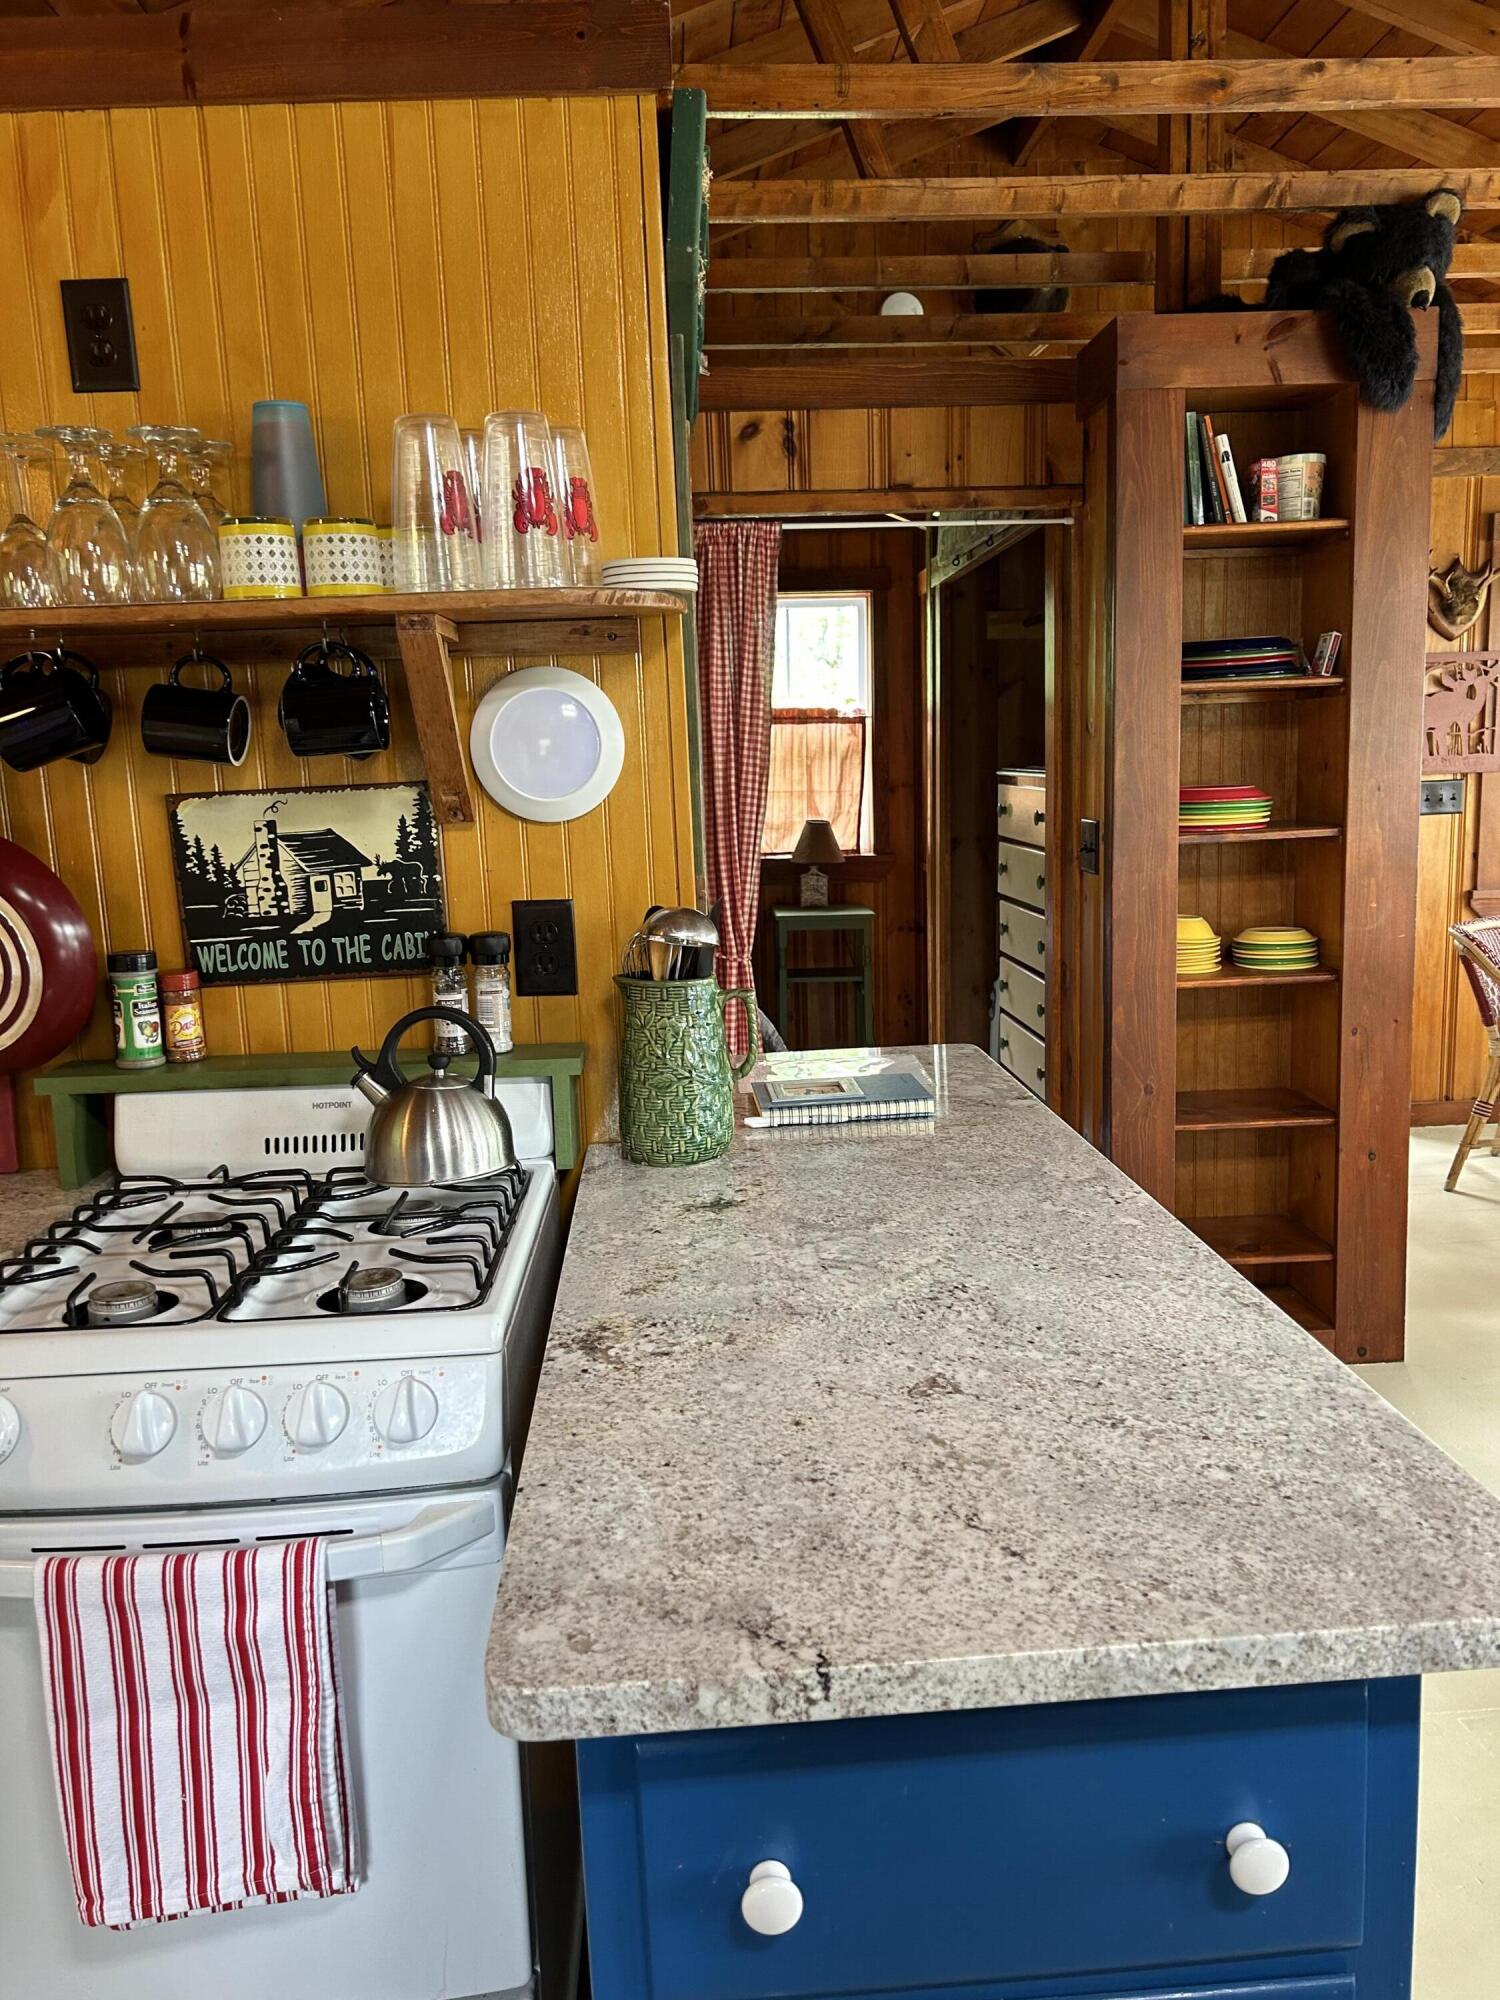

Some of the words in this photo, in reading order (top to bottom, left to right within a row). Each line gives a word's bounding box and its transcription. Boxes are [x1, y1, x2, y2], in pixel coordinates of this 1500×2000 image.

[197, 939, 289, 974] WELCOME
[297, 939, 326, 966] TO
[332, 934, 372, 964] THE
[381, 930, 434, 961] CABI
[312, 1101, 352, 1110] HOTPOINT
[230, 1377, 244, 1385] OFF
[377, 1378, 388, 1387] LO
[207, 1387, 218, 1395] LO
[292, 1383, 303, 1391] LO
[121, 1391, 132, 1399] LO
